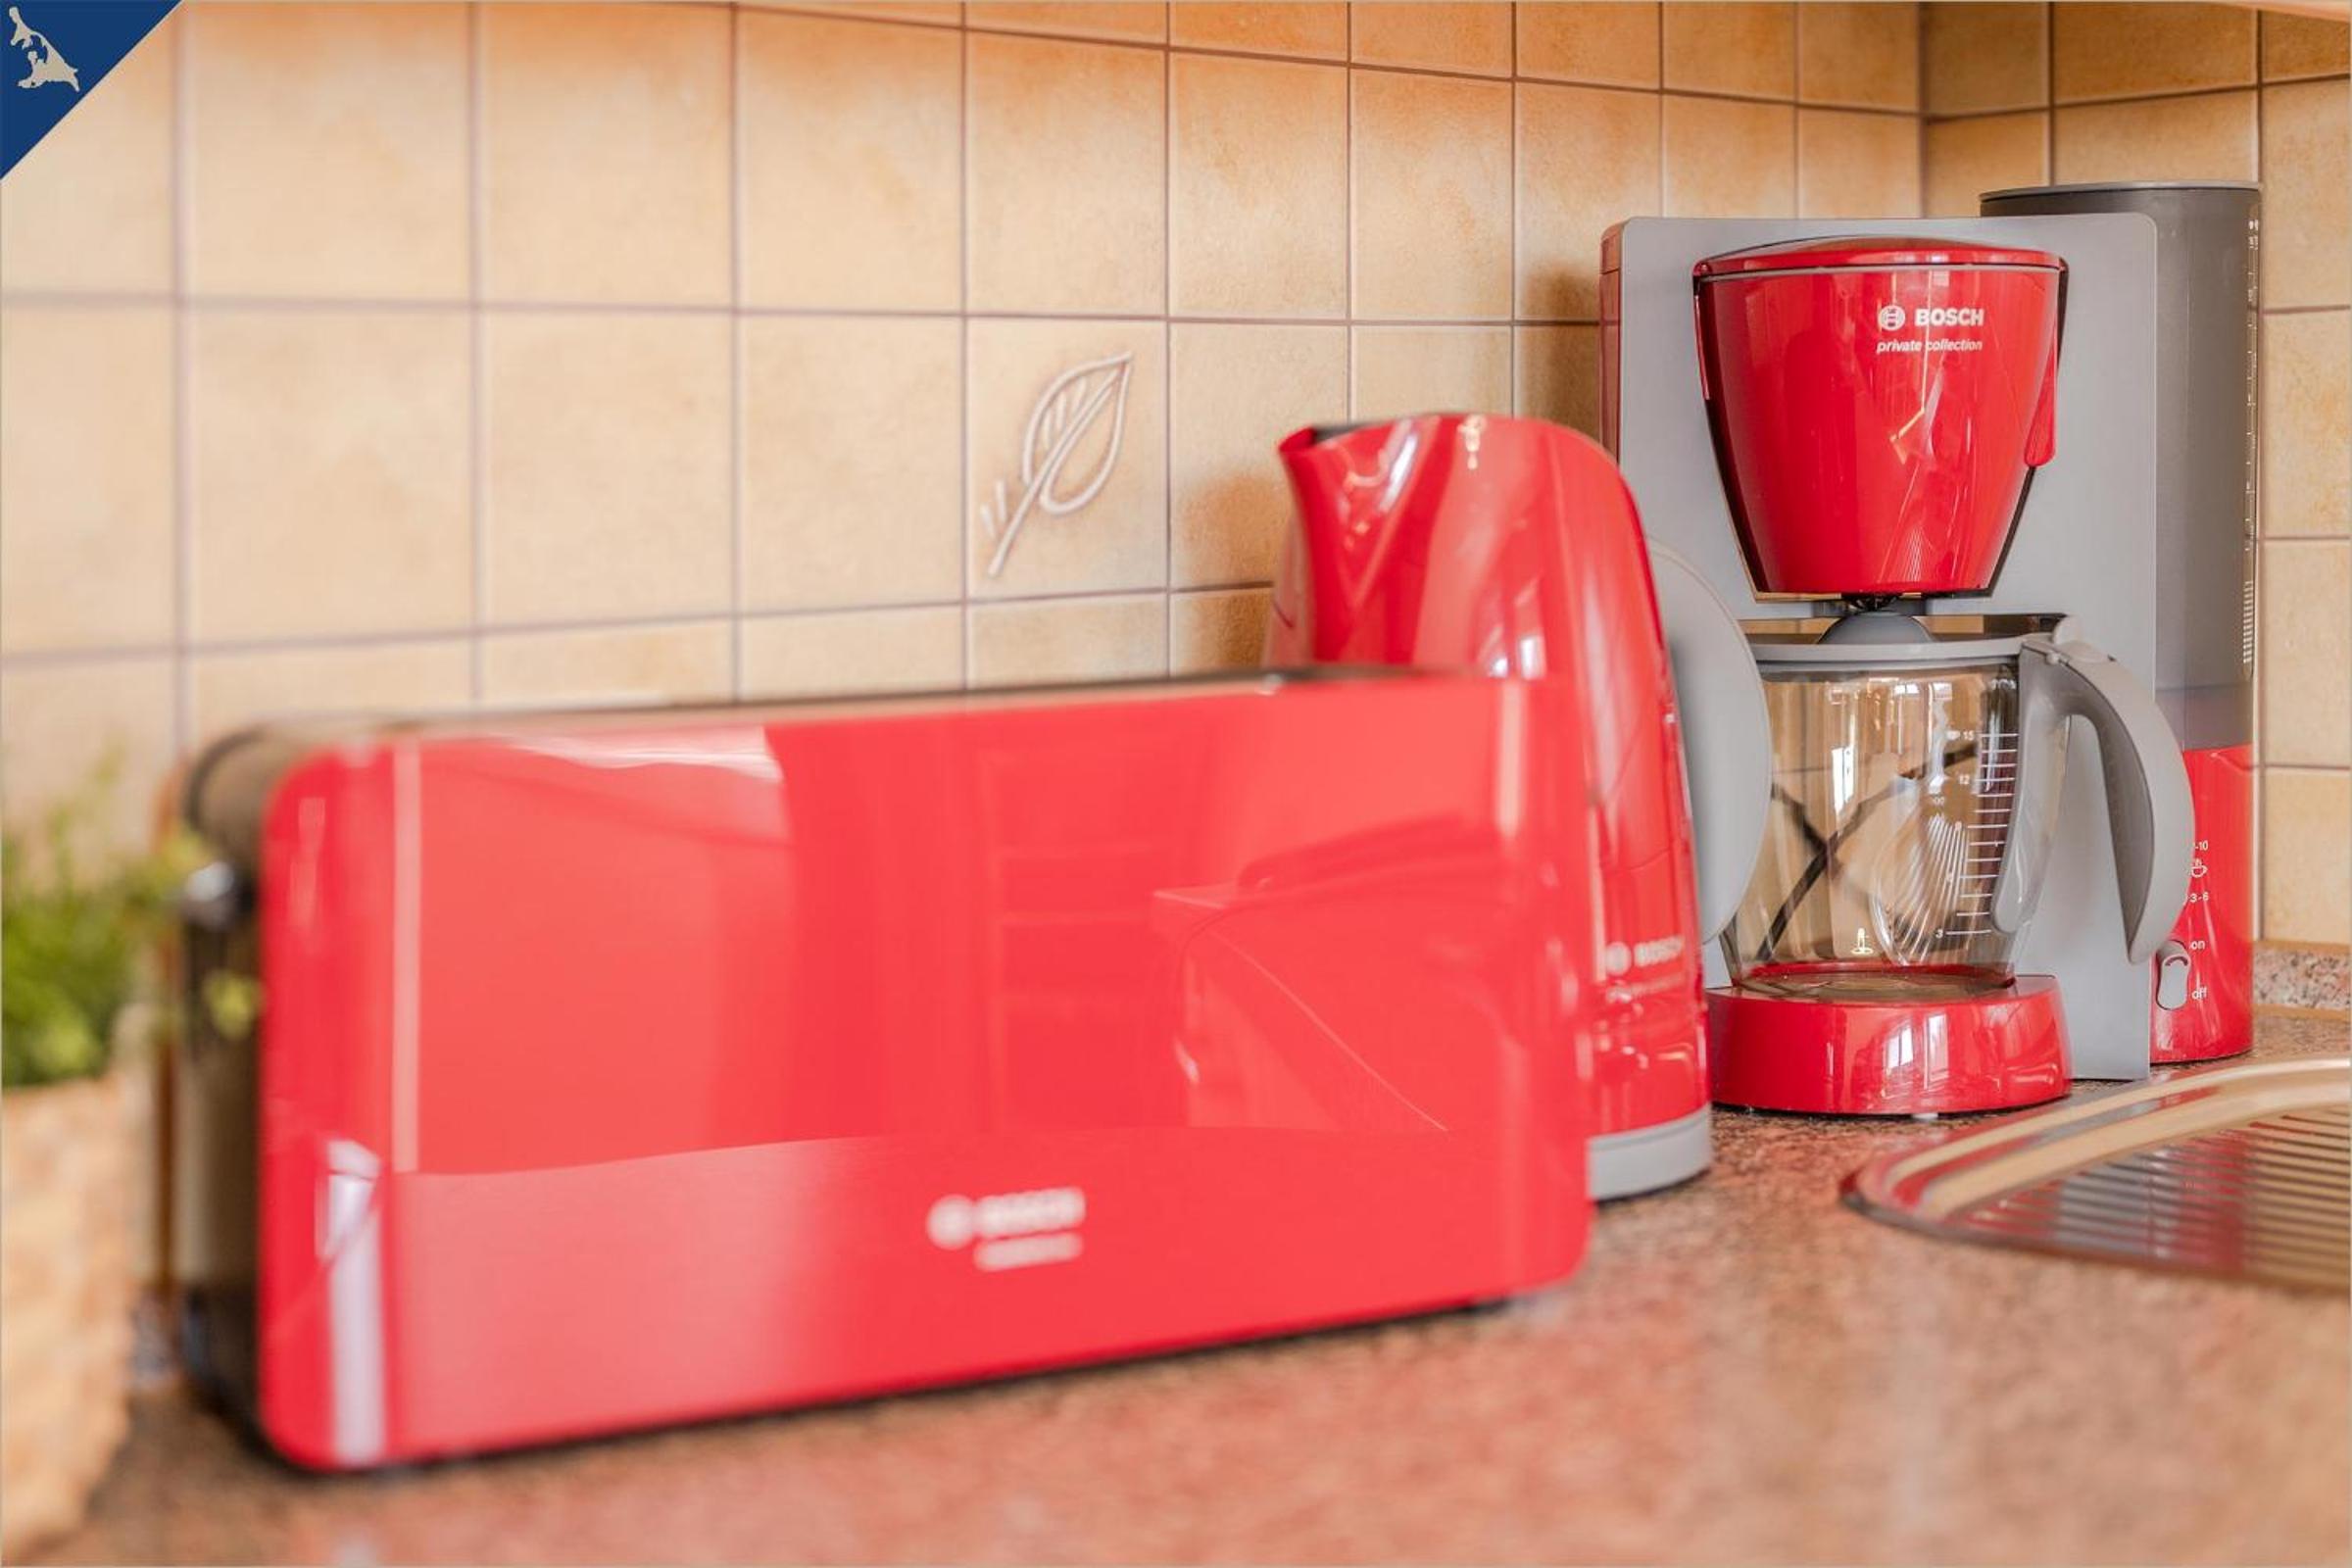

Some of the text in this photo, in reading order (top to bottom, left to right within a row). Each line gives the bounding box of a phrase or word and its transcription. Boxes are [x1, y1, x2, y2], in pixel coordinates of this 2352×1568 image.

[1914, 307, 1984, 326] BOSCH
[1876, 338, 1983, 355] private collection
[1963, 730, 1975, 741] 15
[1959, 774, 1970, 785] 12
[1936, 929, 1943, 939] 3
[2190, 940, 2205, 950] on
[2191, 986, 2207, 1000] off
